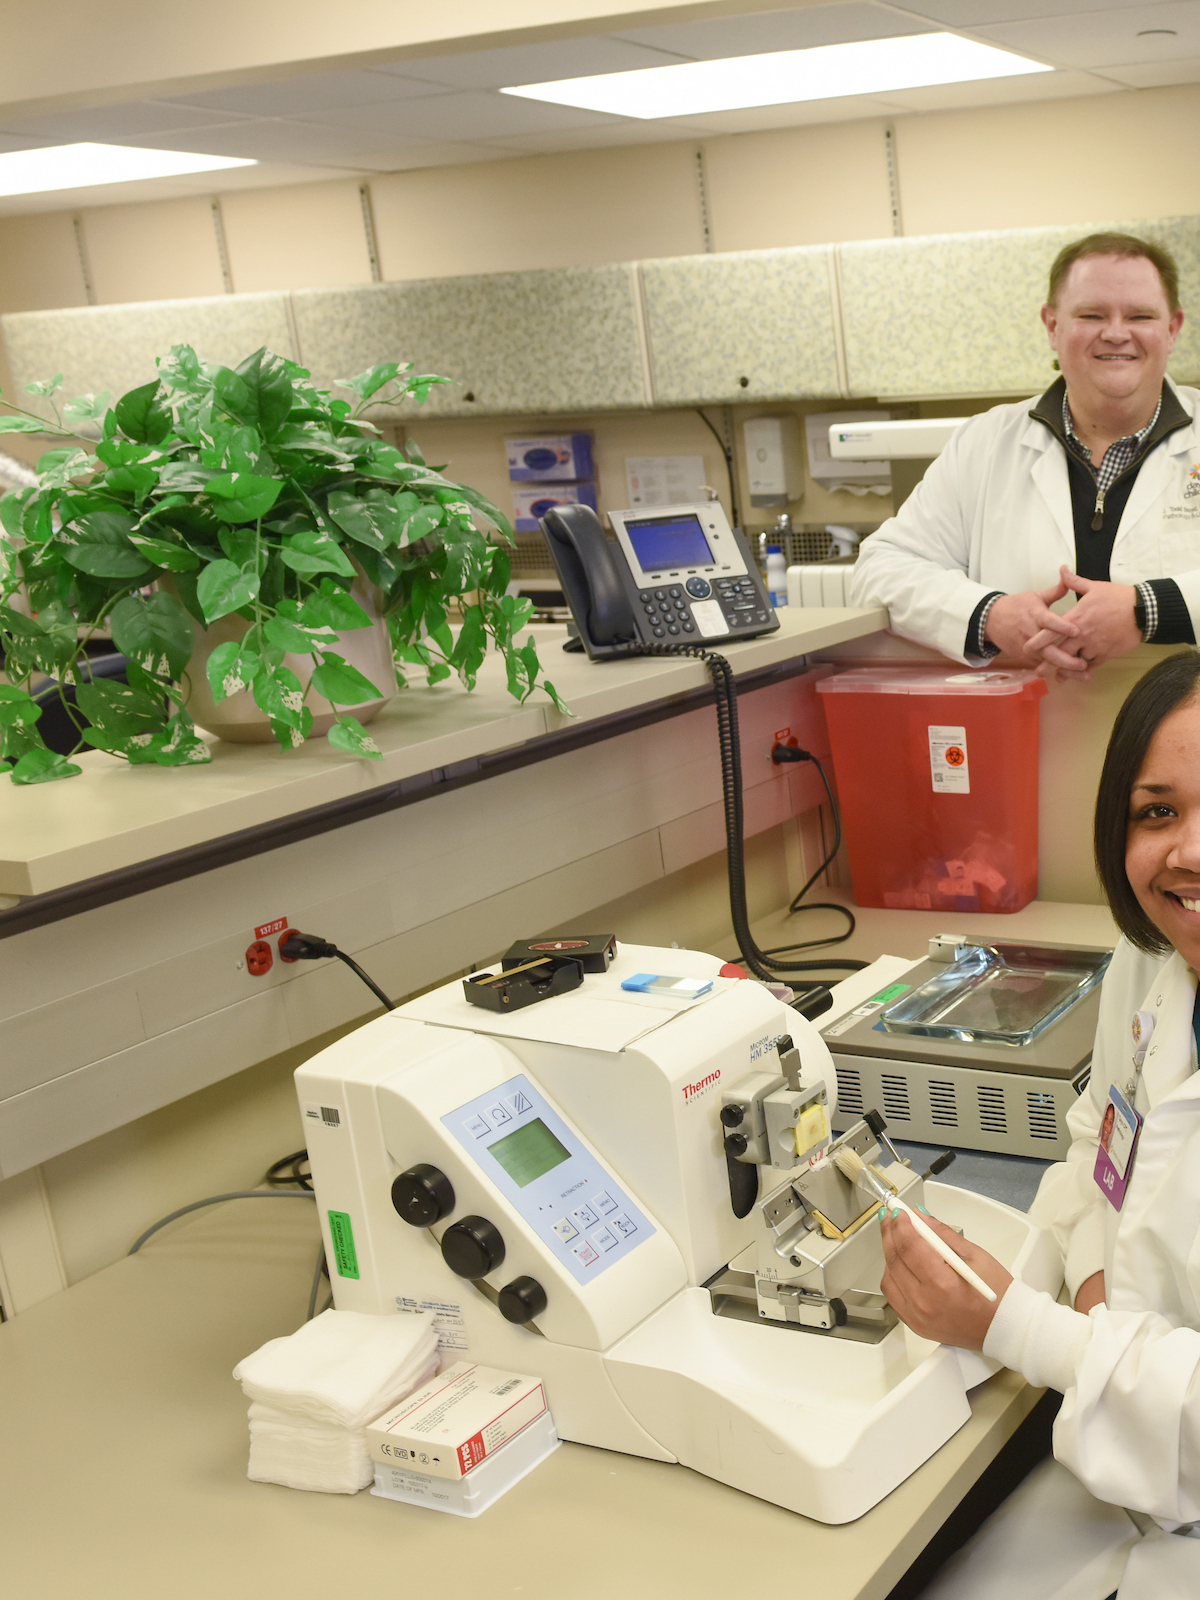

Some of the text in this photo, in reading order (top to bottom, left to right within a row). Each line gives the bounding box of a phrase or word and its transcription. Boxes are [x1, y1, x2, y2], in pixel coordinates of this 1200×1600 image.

[750, 1048, 762, 1063] HM
[682, 1069, 721, 1099] Thermo
[685, 1080, 722, 1106] SCIENTIFIC
[471, 1122, 483, 1131] MENU
[1103, 1167, 1115, 1191] LAB
[560, 1181, 585, 1198] RETRACTION
[336, 1221, 344, 1247] CHECKED
[579, 1248, 590, 1257] START
[583, 1252, 593, 1261] STOP
[460, 1444, 473, 1471] 72 PCS
